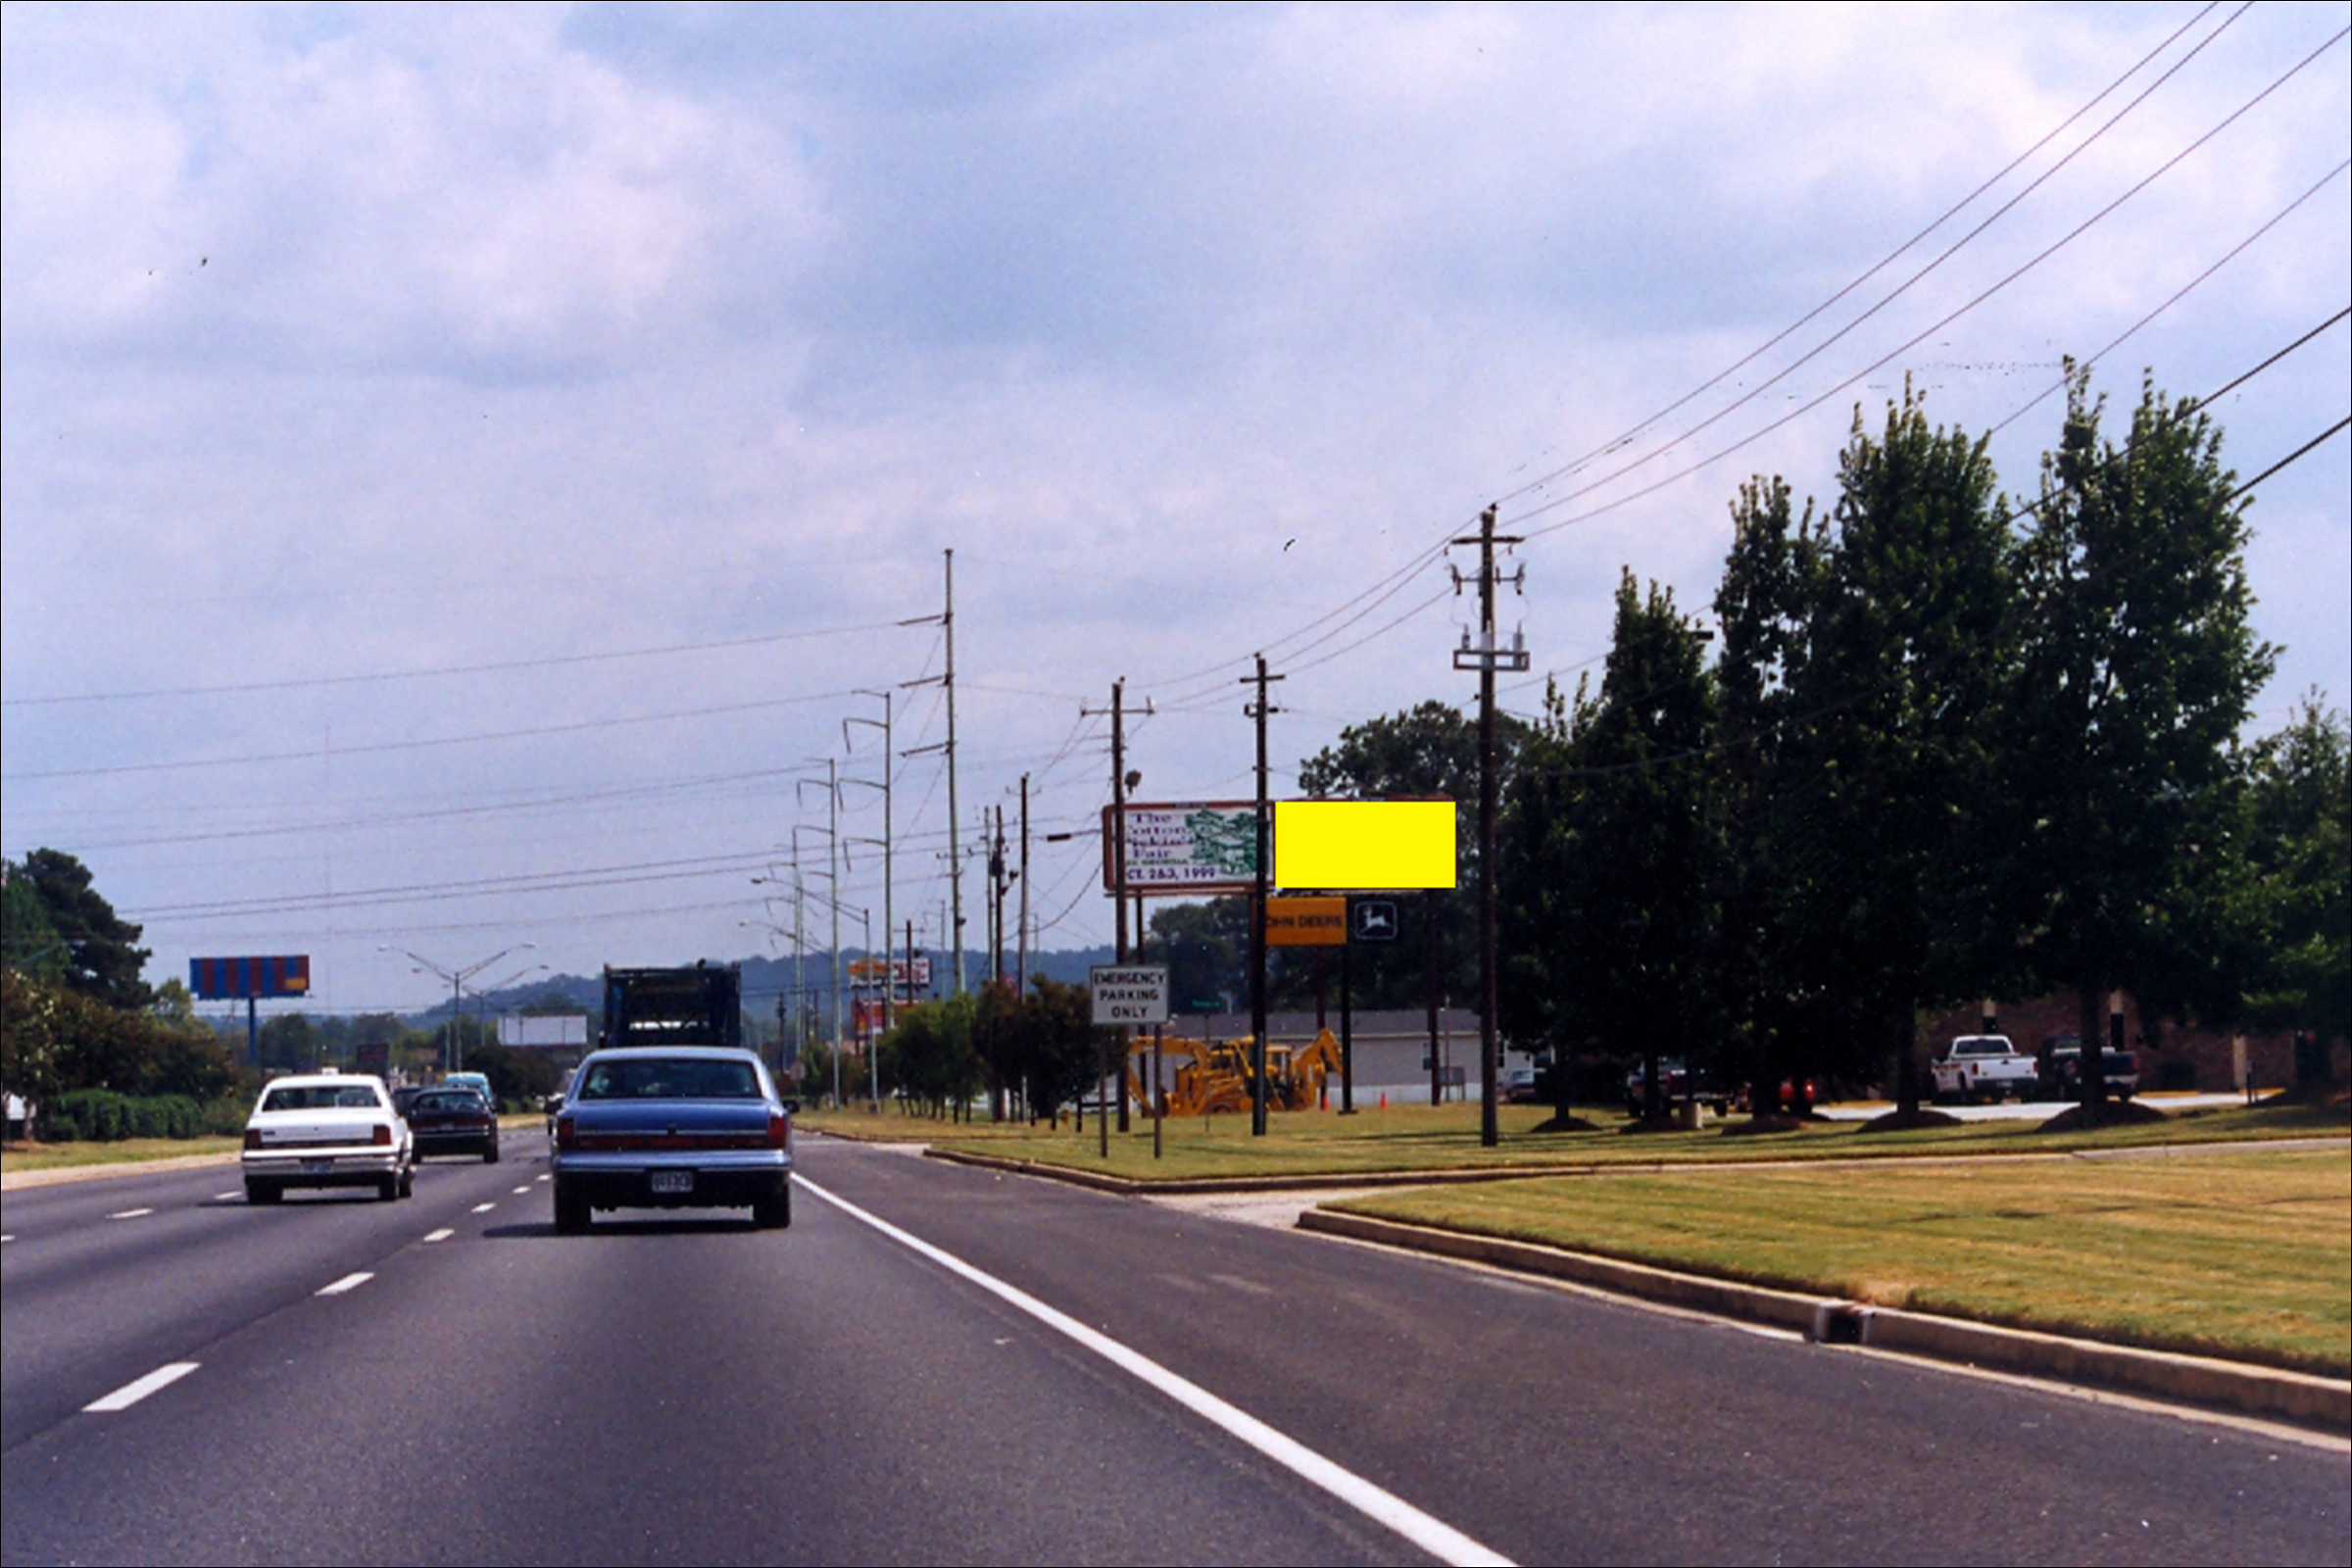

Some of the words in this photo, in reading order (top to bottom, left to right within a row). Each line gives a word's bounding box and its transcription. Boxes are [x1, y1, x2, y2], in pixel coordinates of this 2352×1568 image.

[1130, 811, 1172, 823] The
[1133, 847, 1172, 858] Fair
[1126, 868, 1145, 880] CT.
[1184, 866, 1216, 879] 1999
[1265, 914, 1295, 928] OHN
[1298, 913, 1344, 929] DEERE
[1094, 971, 1164, 986] EMERGENCY
[1100, 988, 1159, 1001] PARKING
[1110, 1005, 1149, 1018] ONLY
